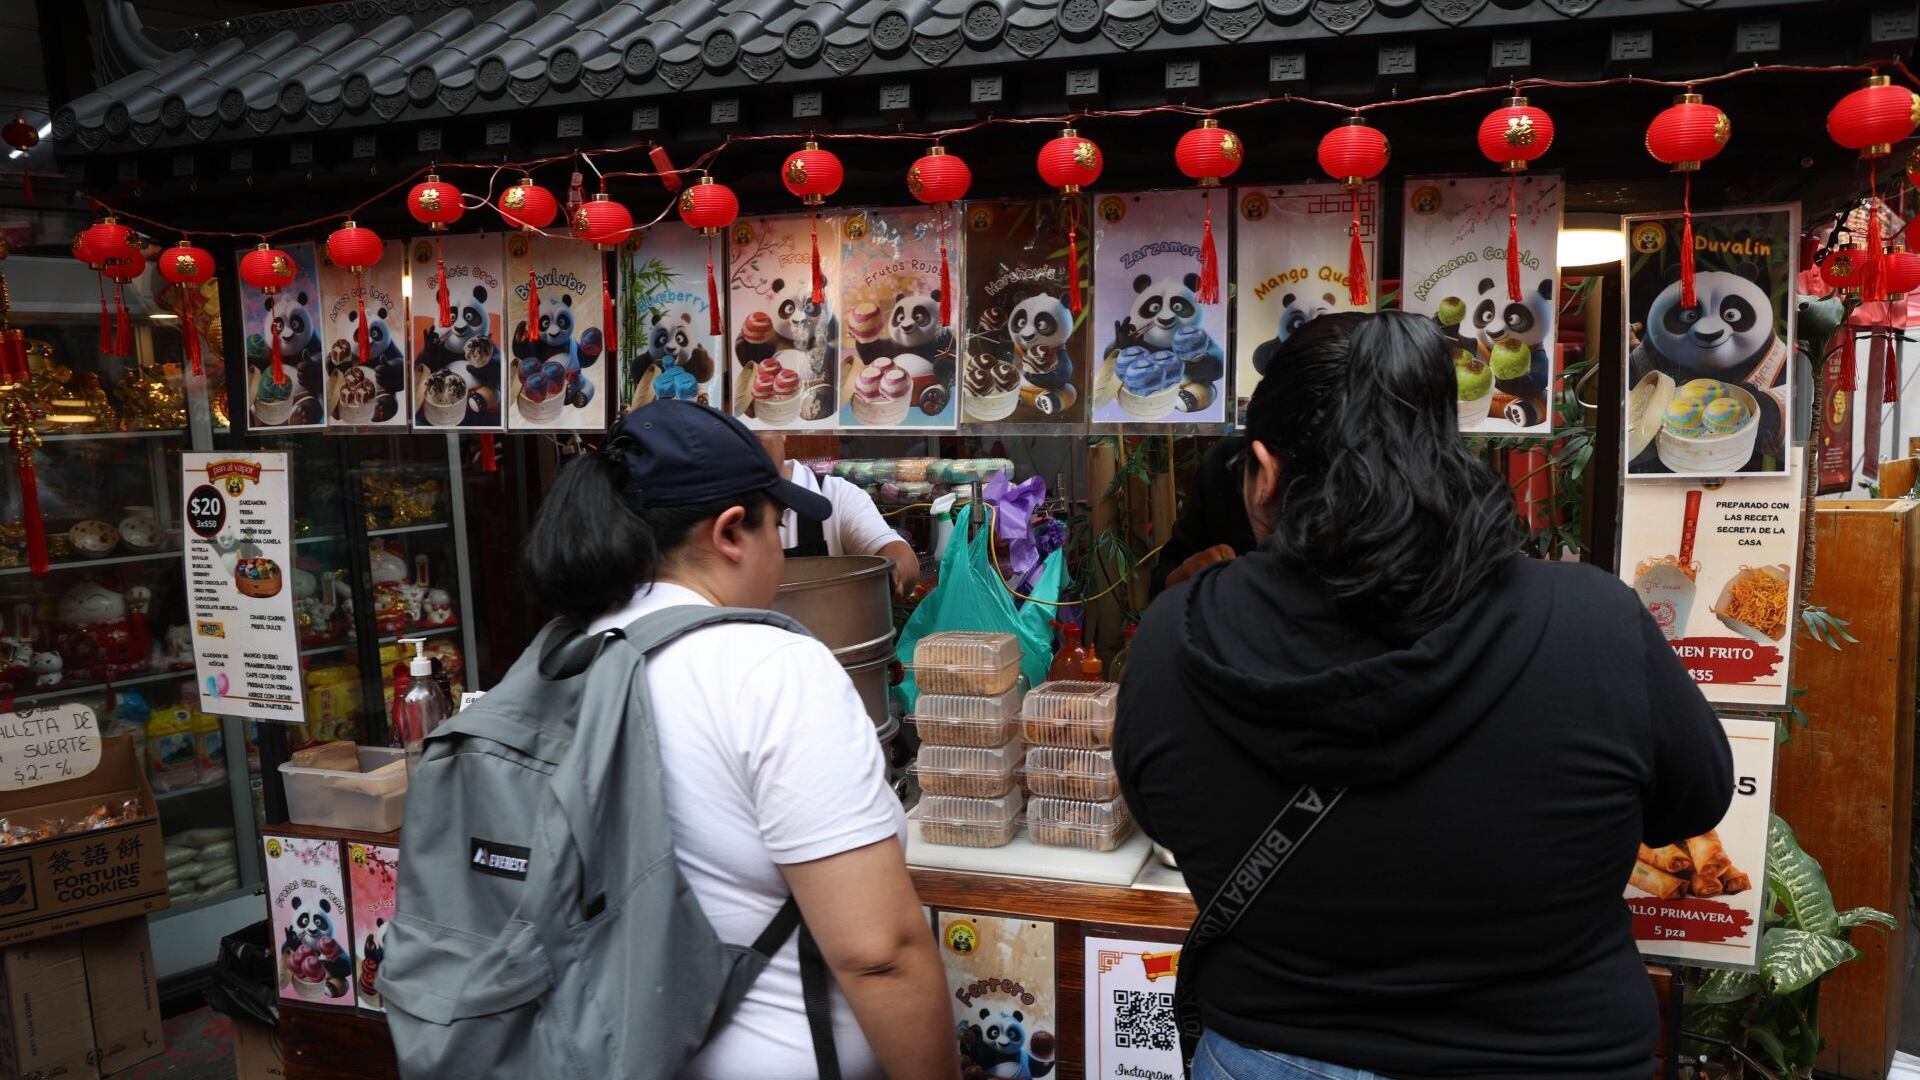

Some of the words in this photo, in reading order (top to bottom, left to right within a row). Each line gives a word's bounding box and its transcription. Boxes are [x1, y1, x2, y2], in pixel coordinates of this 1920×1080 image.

[1120, 241, 1206, 269] Zarzamora
[1694, 235, 1772, 256] Duvalin
[779, 253, 811, 268] Fres
[427, 265, 468, 289] Galeta
[472, 267, 498, 288] Oreo
[865, 261, 905, 287] Frutos
[911, 259, 943, 277] Rojos
[1254, 266, 1310, 300] Mango
[1318, 265, 1351, 288] Que
[1414, 251, 1477, 301] Manzana
[1483, 246, 1540, 270] Caela
[636, 289, 711, 313] Blueberry
[191, 497, 220, 517] $20
[1716, 501, 1769, 509] PREPARADO
[1770, 502, 1790, 510] CON
[1744, 514, 1779, 522] RECETA
[1716, 526, 1757, 534] SECRETA
[1758, 527, 1771, 535] DE
[1772, 527, 1786, 535] LA
[1738, 539, 1762, 547] CASA
[1671, 645, 1705, 658] MEN
[1708, 646, 1754, 660] FRITO
[1688, 668, 1714, 682] $35
[0, 717, 60, 739] ALLETA
[73, 711, 92, 730] DE
[24, 735, 91, 759] SUERTE
[53, 861, 141, 891] FORTUNE
[1223, 829, 1293, 905] BIMBA
[58, 875, 141, 903] COOKIES
[1215, 902, 1237, 921] Y
[1628, 904, 1657, 916] LLO
[1660, 907, 1735, 924] PRIMAVERA
[1654, 925, 1662, 935] 5
[1665, 928, 1686, 938] pza
[955, 976, 1035, 1009] Ferrero
[1114, 1063, 1173, 1080] Instagram
